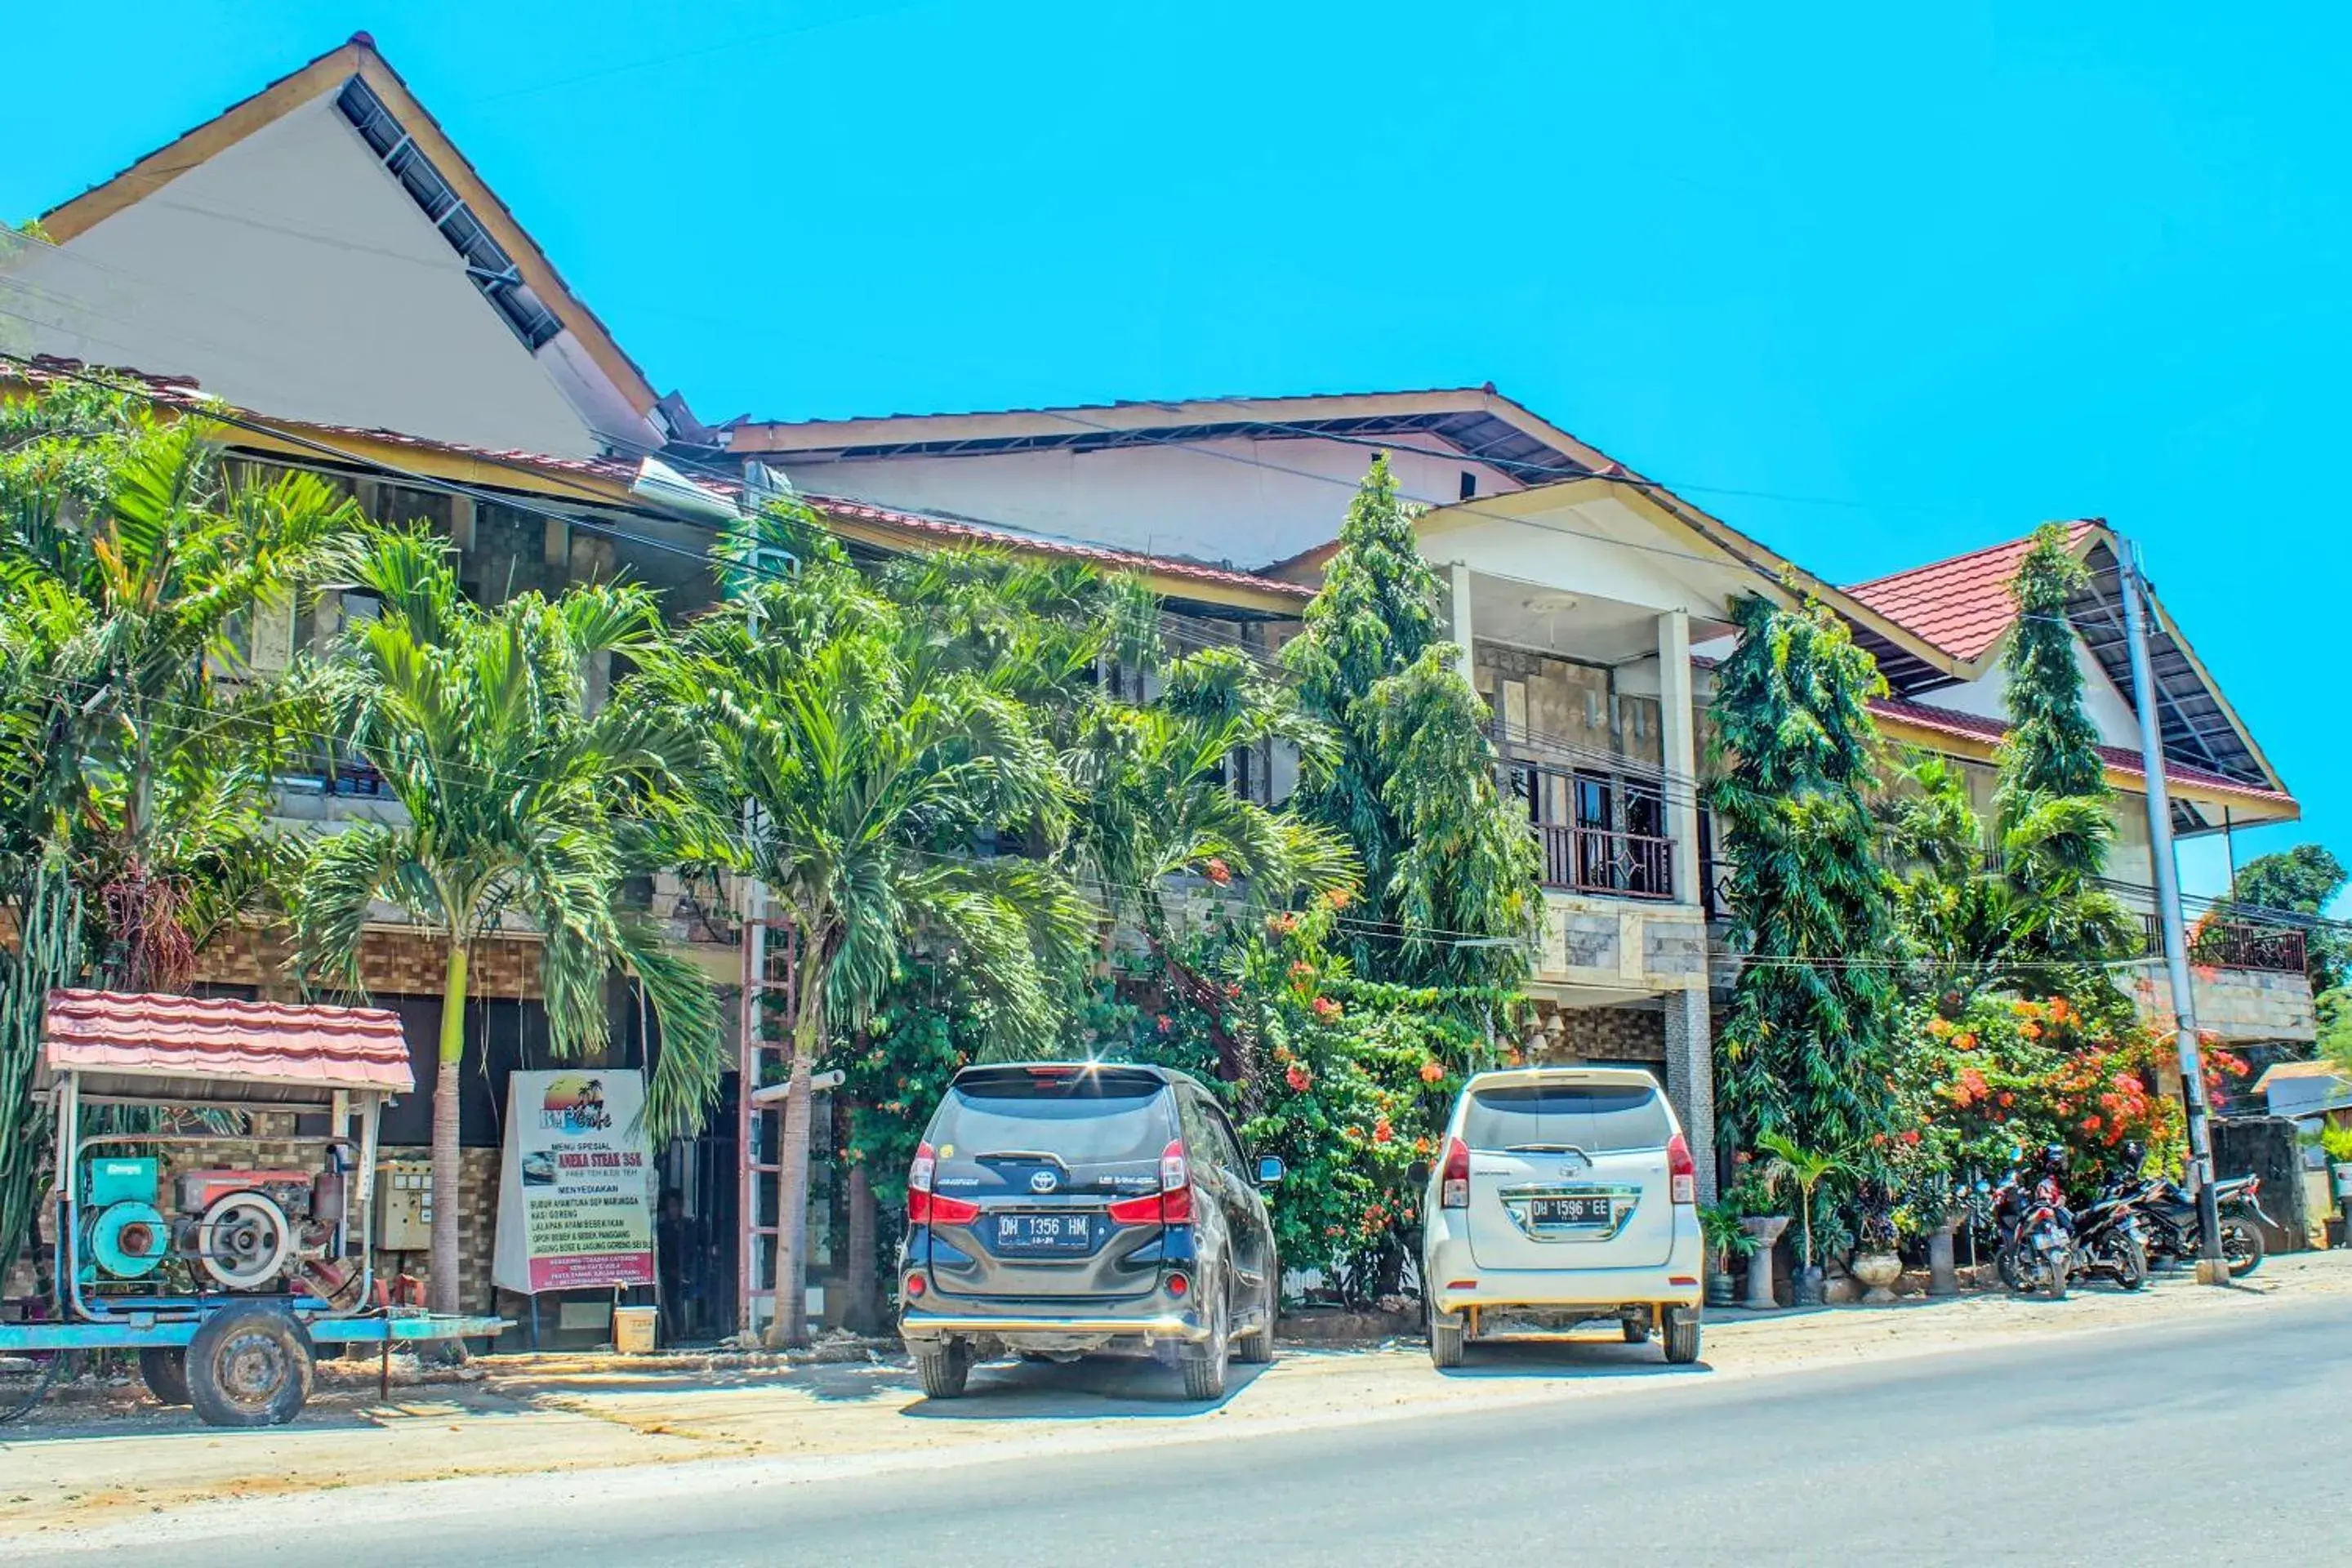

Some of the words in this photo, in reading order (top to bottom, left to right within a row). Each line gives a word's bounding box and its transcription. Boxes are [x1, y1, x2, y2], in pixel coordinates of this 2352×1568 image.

[577, 1142, 612, 1151] SPESIAL
[590, 1152, 621, 1167] STEAK
[558, 1185, 619, 1194] MENYEDIAKAN
[1556, 1200, 1584, 1216] 1596
[1592, 1199, 1608, 1215] EE
[1029, 1217, 1060, 1236] 1356
[1068, 1217, 1087, 1236] HM
